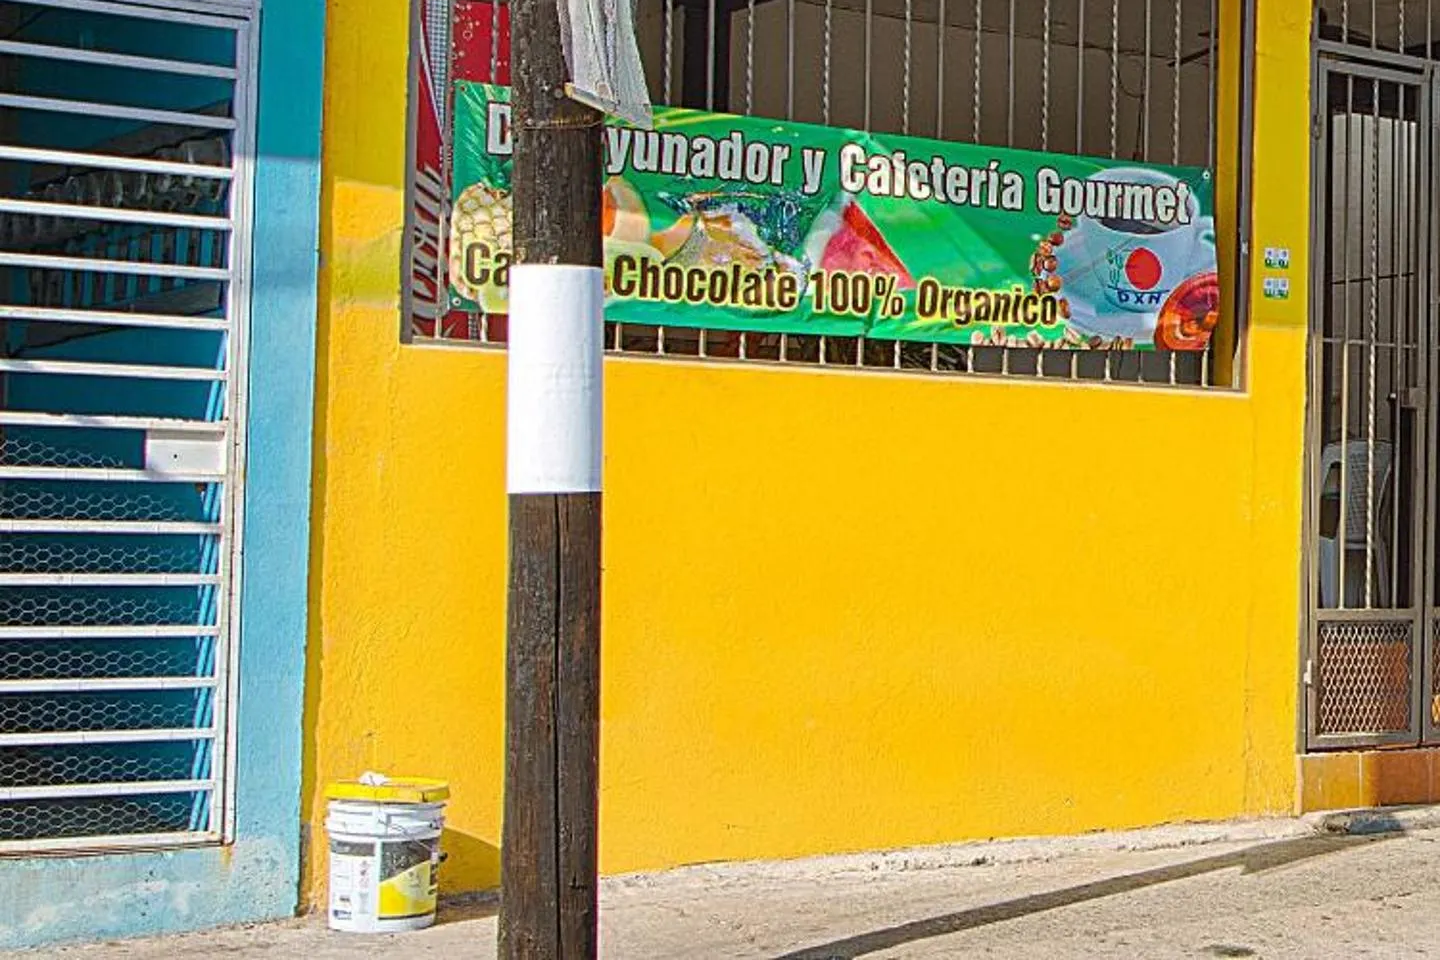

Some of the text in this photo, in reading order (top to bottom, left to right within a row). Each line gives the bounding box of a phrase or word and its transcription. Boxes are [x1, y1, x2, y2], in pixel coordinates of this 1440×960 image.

[486, 101, 1191, 225] Dyunador y Cafetería Gourmet
[613, 255, 798, 309] Chocolate
[811, 269, 904, 316] 100%
[918, 279, 1058, 325] Organico
[1117, 290, 1162, 305] DXN
